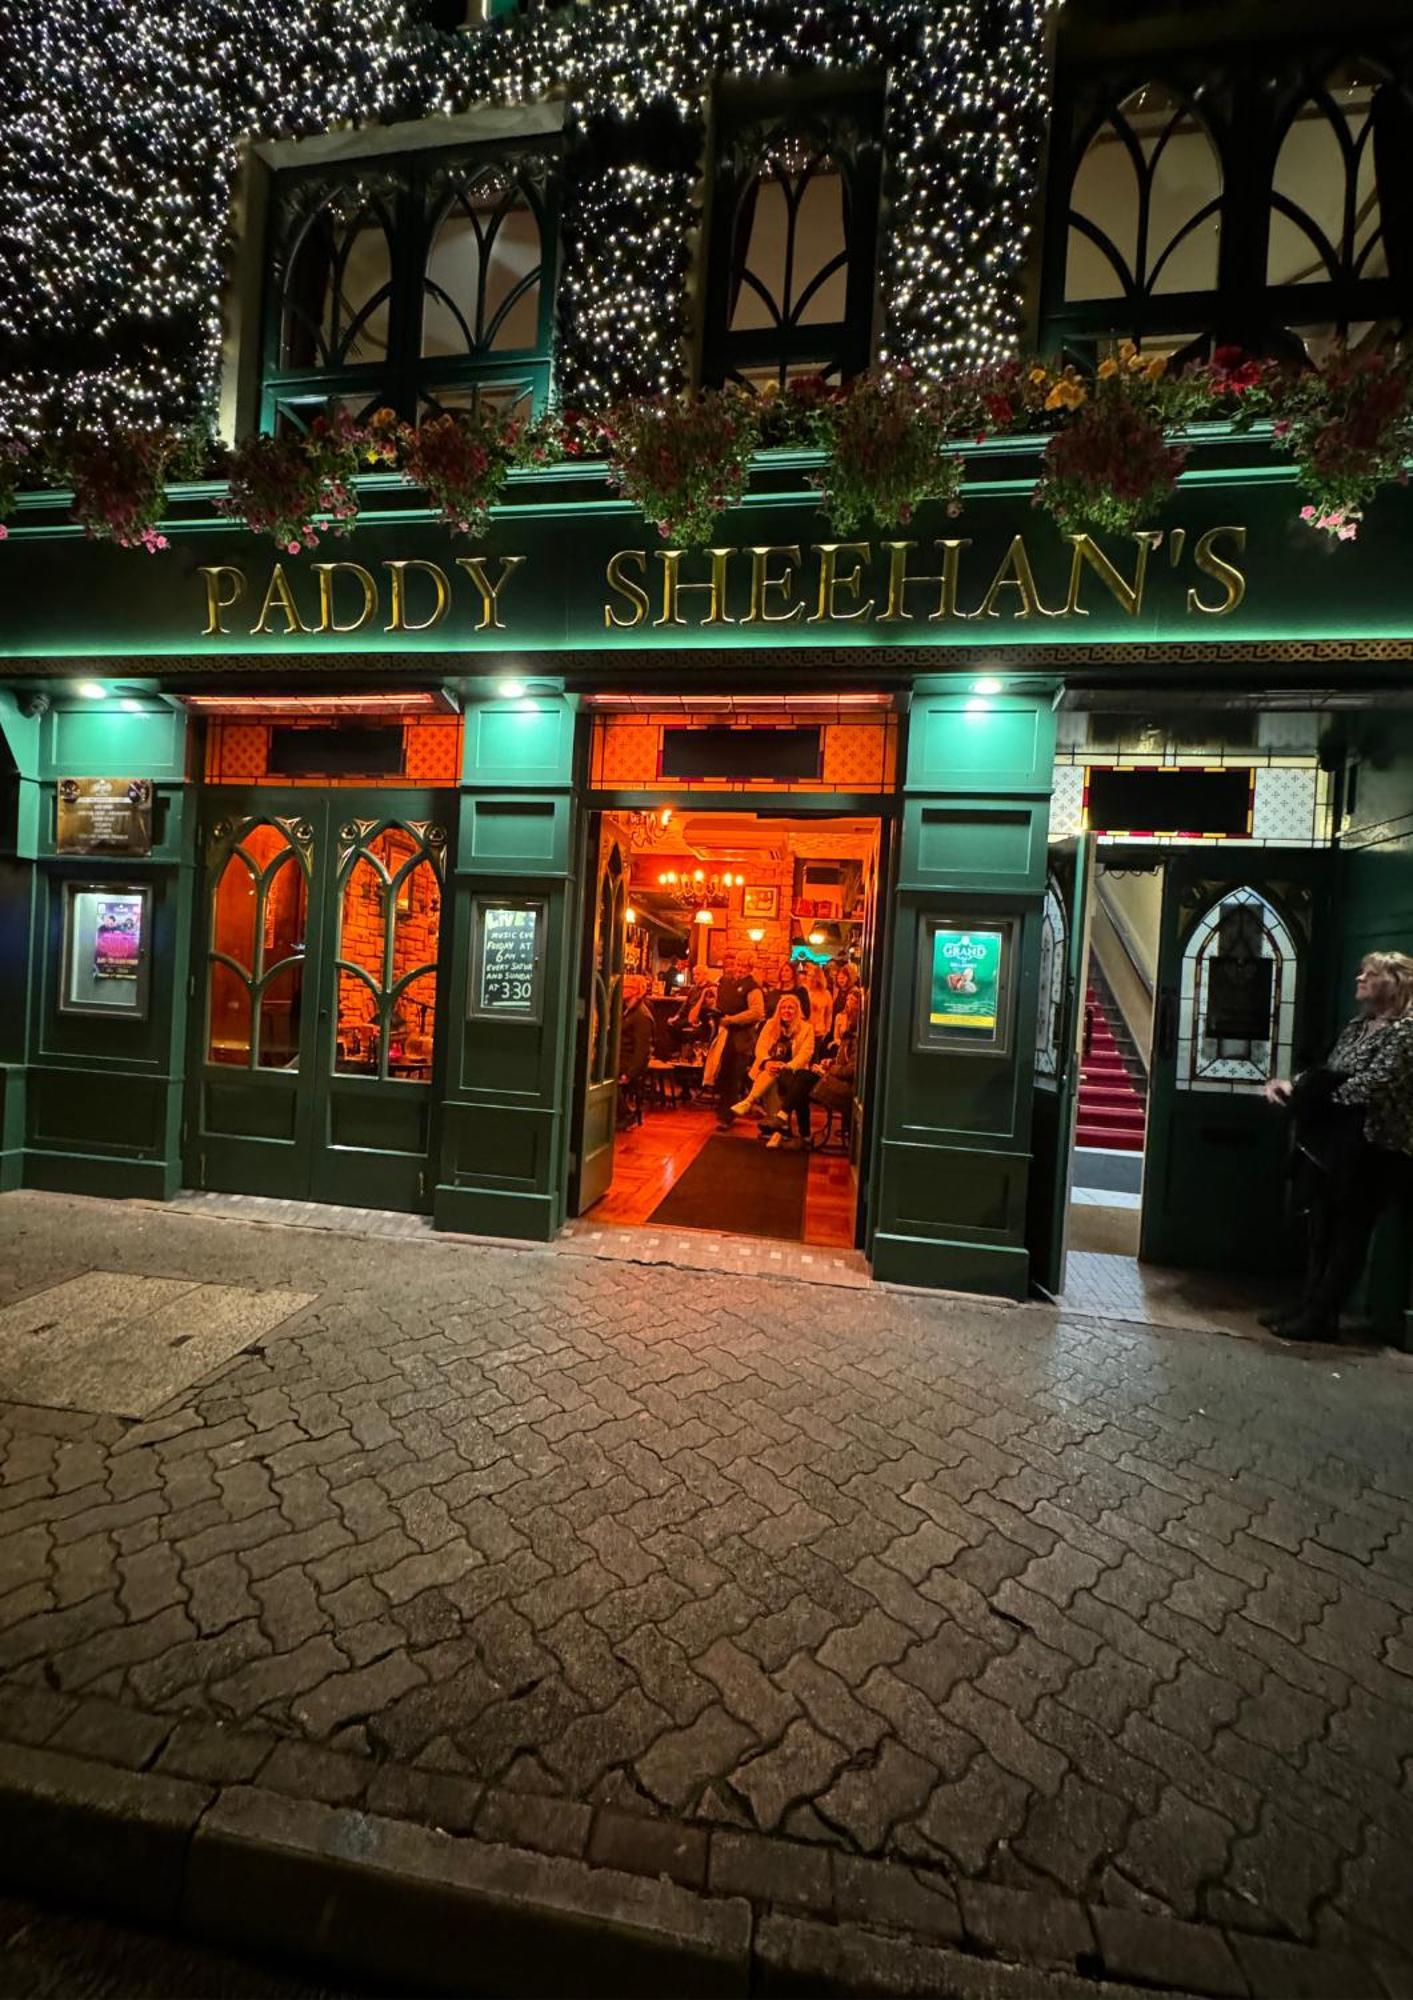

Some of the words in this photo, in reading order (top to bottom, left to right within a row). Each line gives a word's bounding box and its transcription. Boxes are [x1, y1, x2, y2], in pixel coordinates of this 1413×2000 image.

[198, 556, 527, 635] PADDY
[604, 526, 1248, 628] SHEEHAN'S
[491, 931, 517, 940] MUSIC
[486, 941, 514, 951] FRIDAY
[519, 942, 533, 950] AT
[943, 944, 987, 960] GRAND
[486, 964, 509, 972] EVERY
[486, 972, 503, 980] AND
[504, 972, 533, 981] SUNDA
[488, 984, 500, 992] AT
